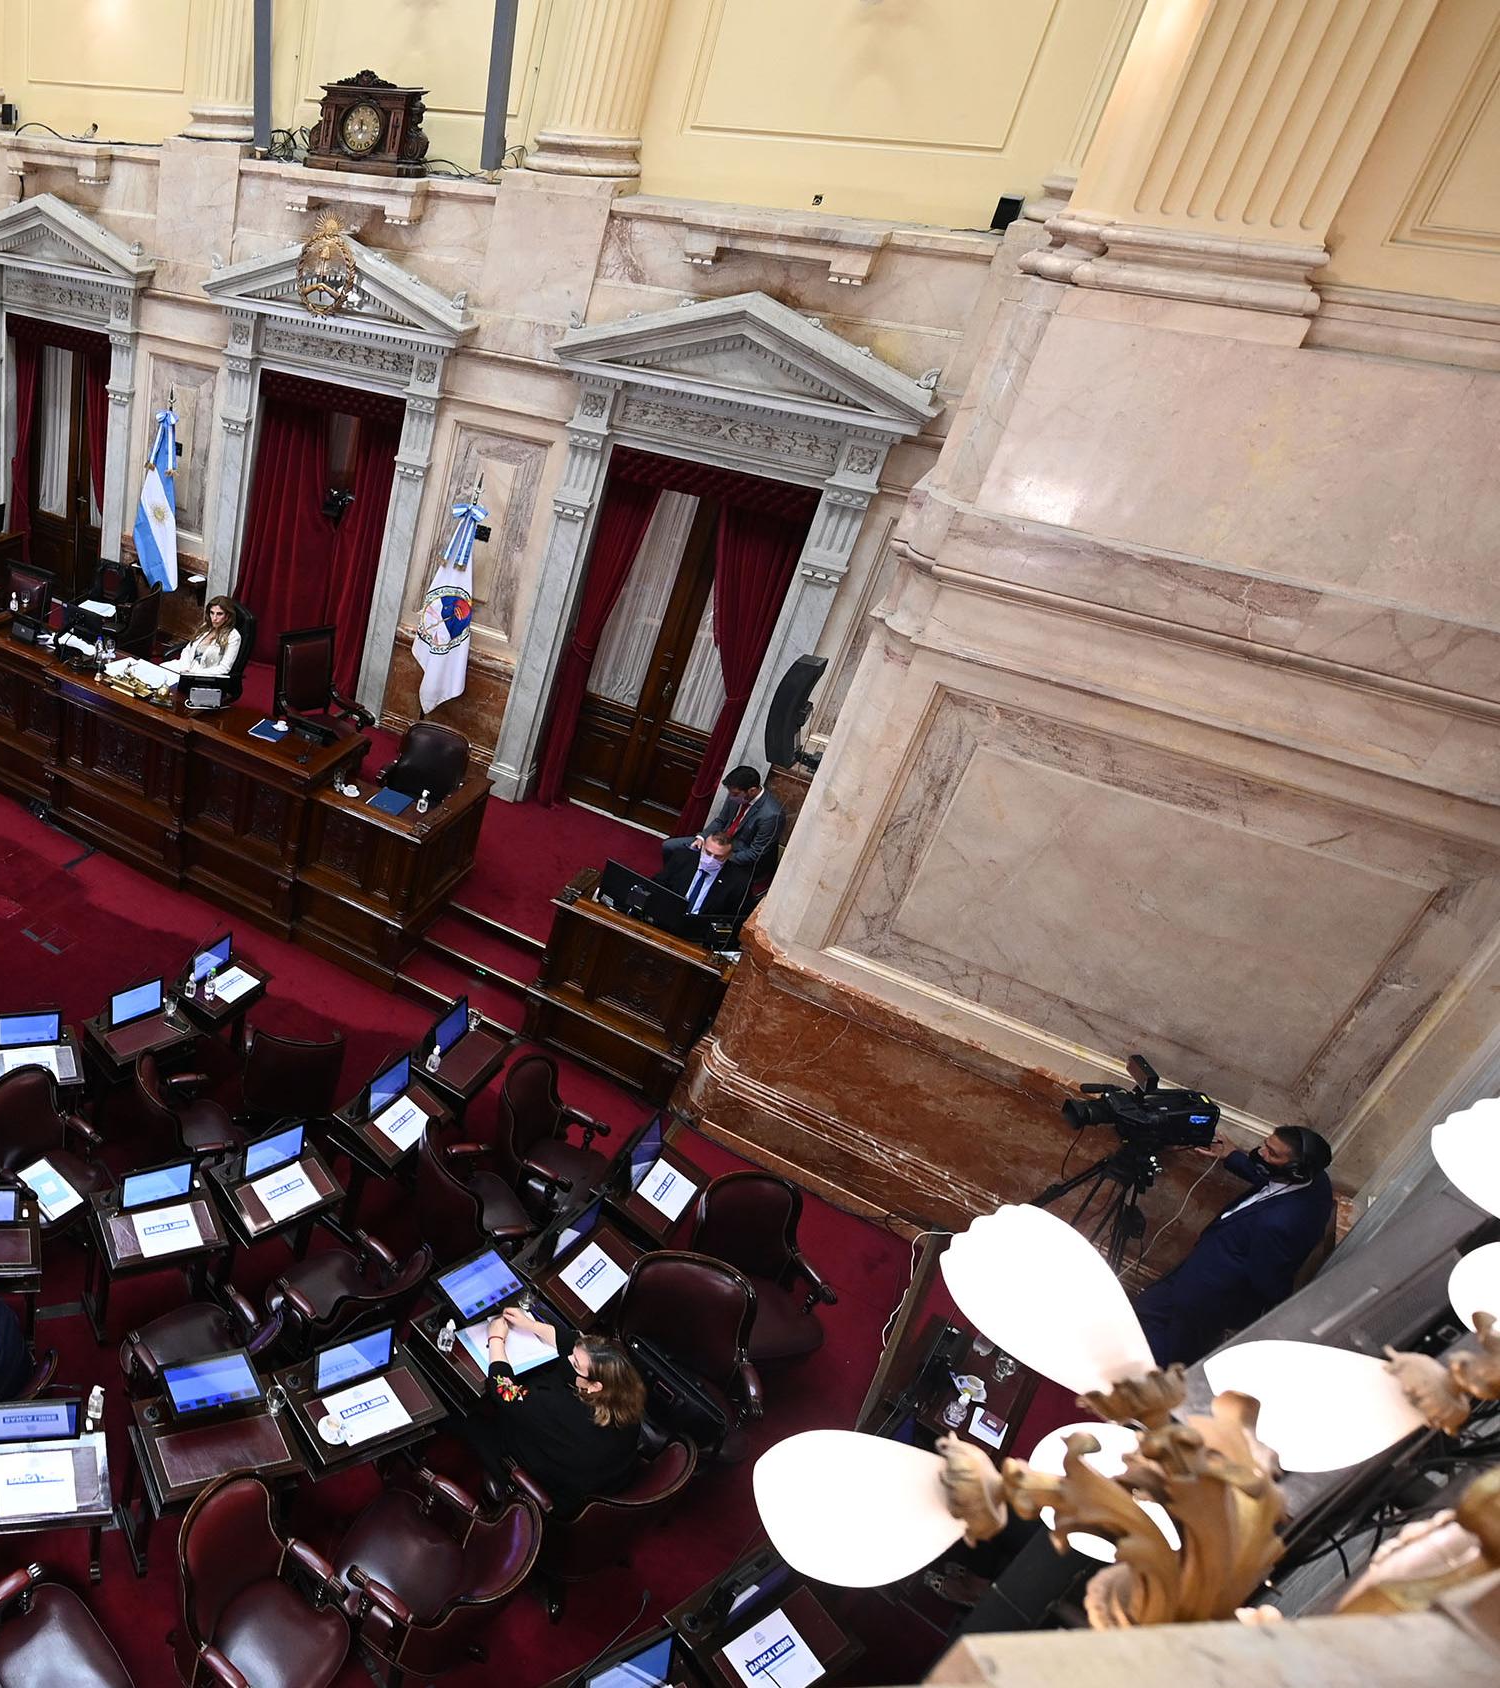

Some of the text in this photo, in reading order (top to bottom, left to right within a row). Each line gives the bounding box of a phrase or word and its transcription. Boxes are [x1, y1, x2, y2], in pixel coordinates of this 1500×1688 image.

[145, 1224, 170, 1235] BANCA
[577, 1269, 596, 1289] BANCA
[341, 1396, 388, 1419] BANCA LIBRE
[747, 1649, 776, 1676] BANCA
[770, 1636, 793, 1659] LIBRE
